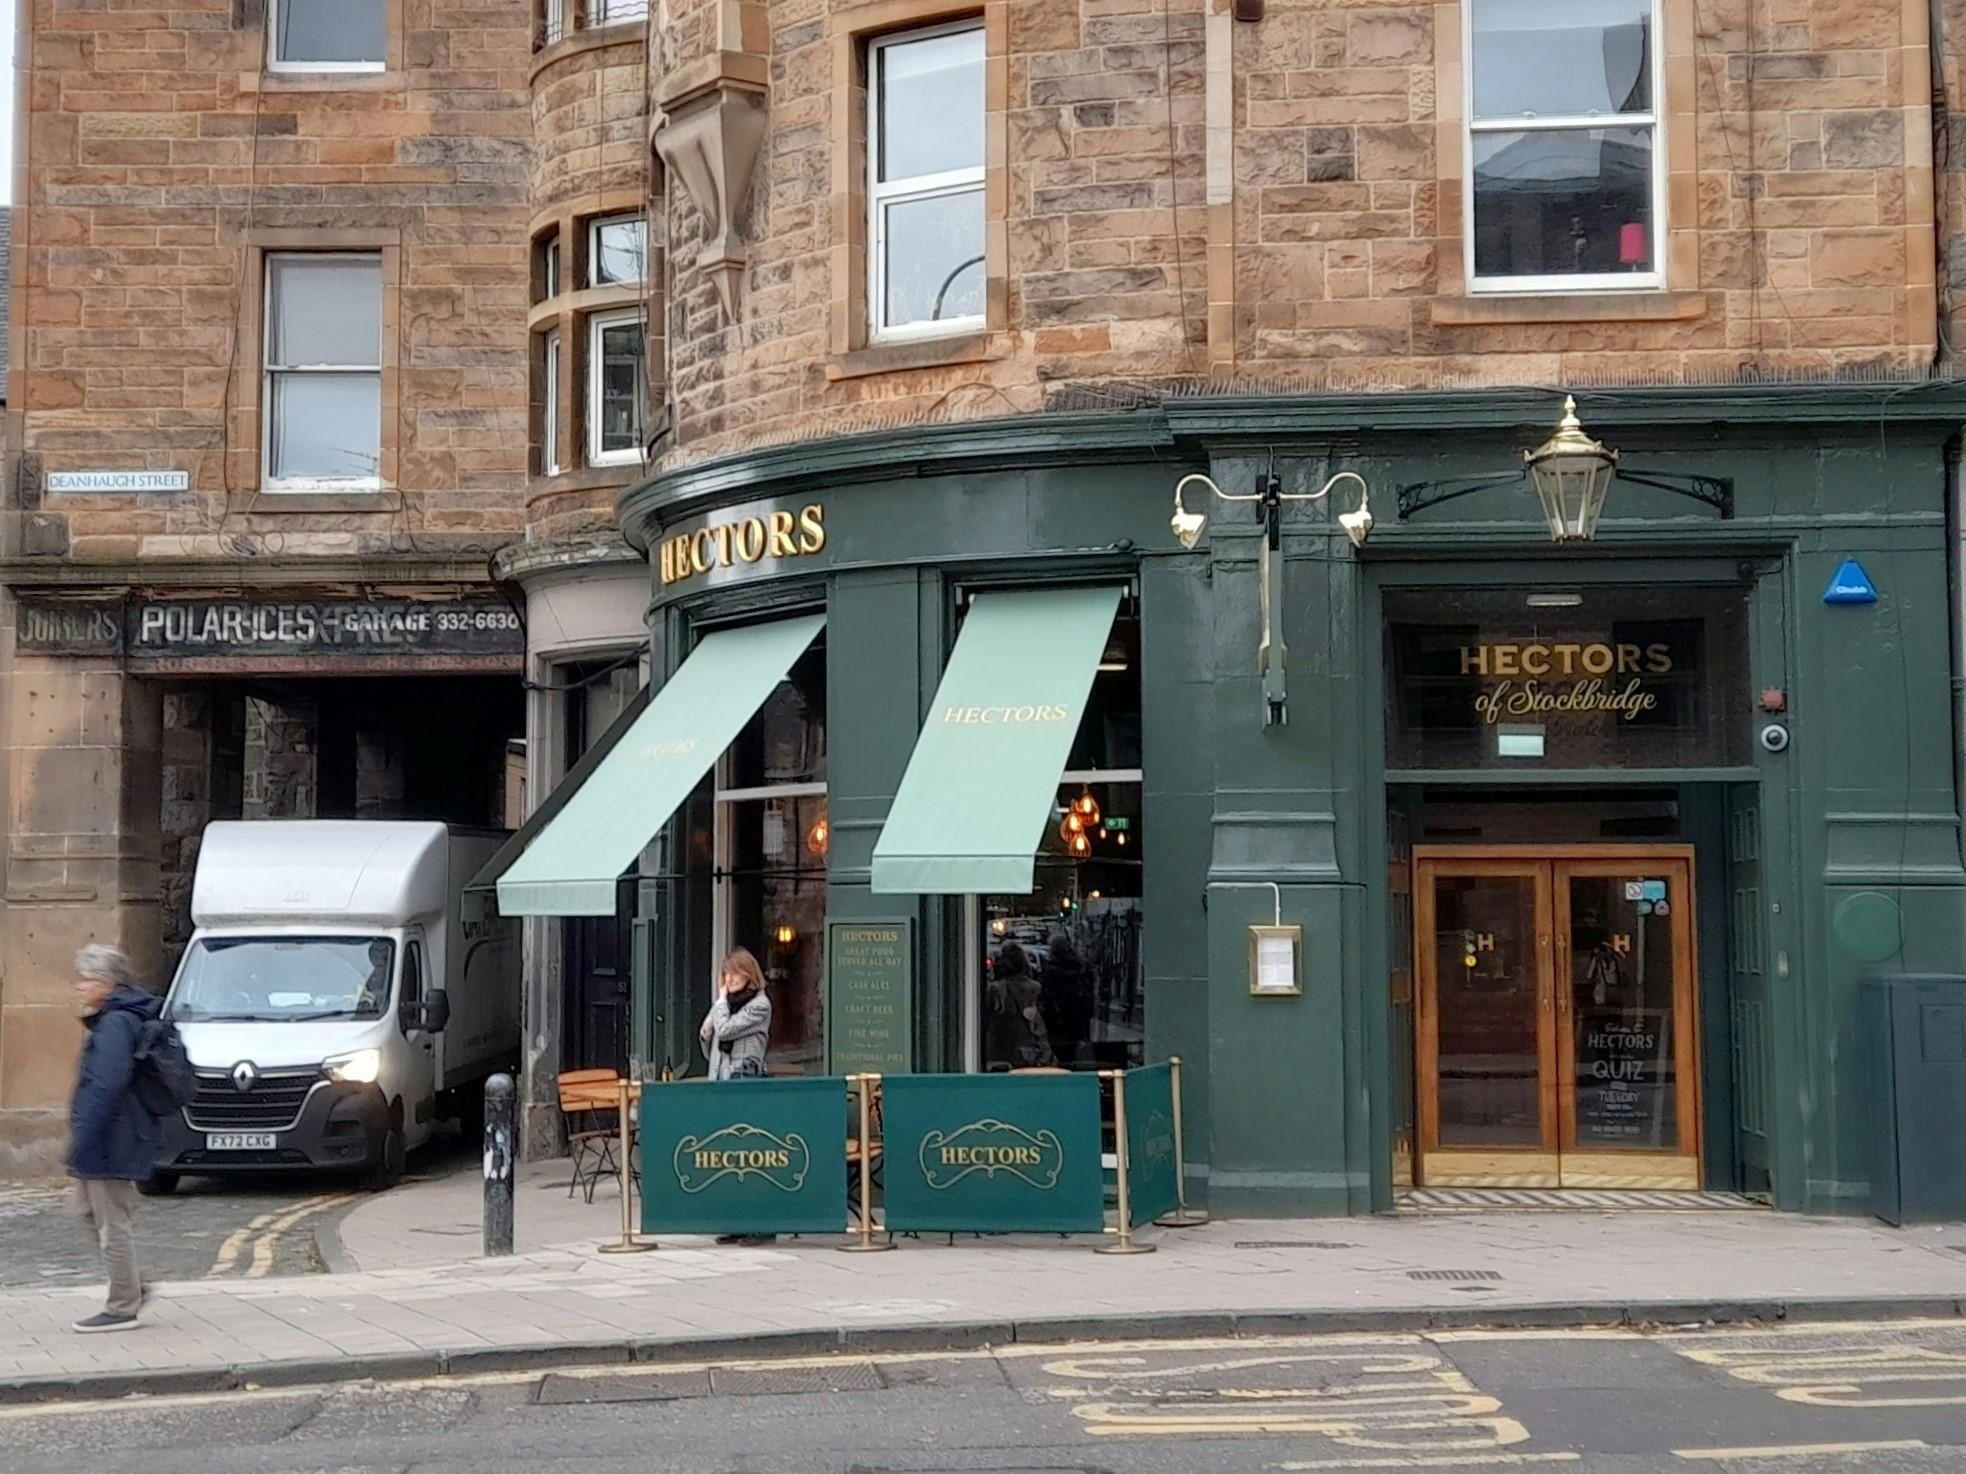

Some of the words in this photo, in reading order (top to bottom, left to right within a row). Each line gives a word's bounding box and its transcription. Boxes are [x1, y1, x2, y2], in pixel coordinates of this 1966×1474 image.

[50, 474, 136, 488] DEANHAUGH
[138, 474, 186, 487] STREET
[660, 504, 827, 585] HECTORS
[344, 612, 432, 632] GARAGE
[437, 611, 519, 631] 332-6630
[1459, 643, 1674, 675] HECTORS
[1474, 679, 1512, 724] of
[1507, 677, 1658, 720] Stockbridge
[943, 703, 1068, 724] HECTORS
[842, 930, 898, 942] HECTORS
[1477, 933, 1495, 952] H
[1613, 933, 1631, 953] H
[1587, 1033, 1656, 1049] HECTORS
[1592, 1060, 1645, 1081] QUIZ
[211, 1135, 244, 1148] FX72
[246, 1135, 271, 1147] CXG
[694, 1150, 790, 1169] HECTORS
[940, 1146, 1041, 1165] HECTORS
